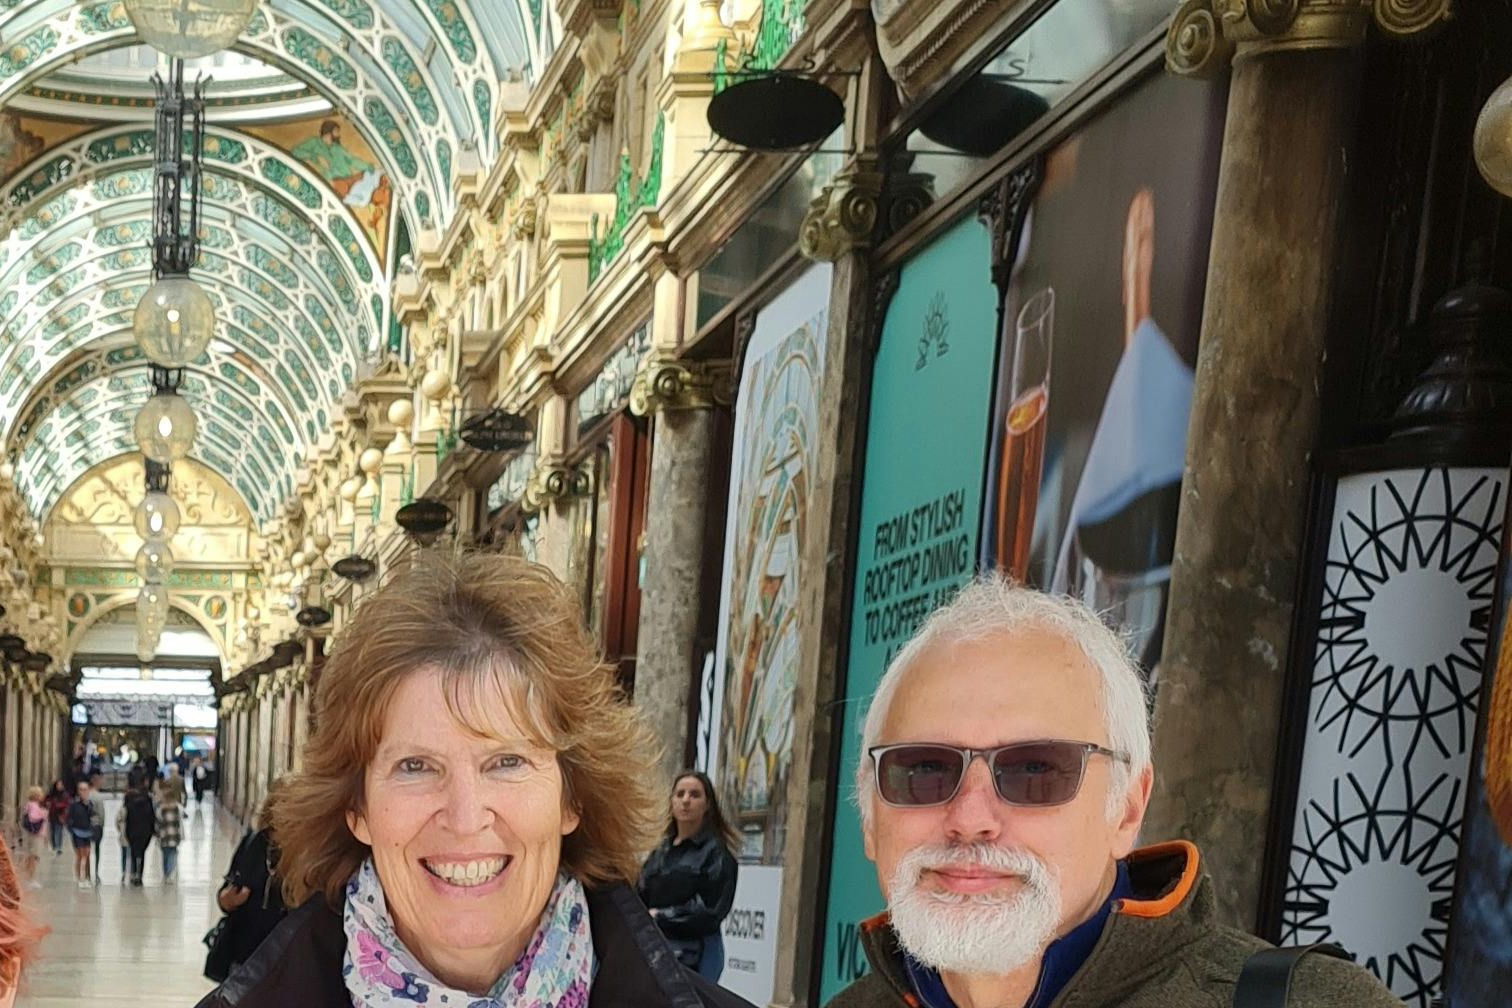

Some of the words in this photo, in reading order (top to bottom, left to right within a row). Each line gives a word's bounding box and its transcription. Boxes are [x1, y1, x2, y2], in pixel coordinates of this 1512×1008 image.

[874, 513, 909, 561] FROM
[910, 488, 965, 545] STYLISH
[864, 552, 920, 605] ROOFTOP
[921, 533, 969, 586] DINING
[865, 606, 881, 647] TO
[881, 593, 929, 642] COFFEE
